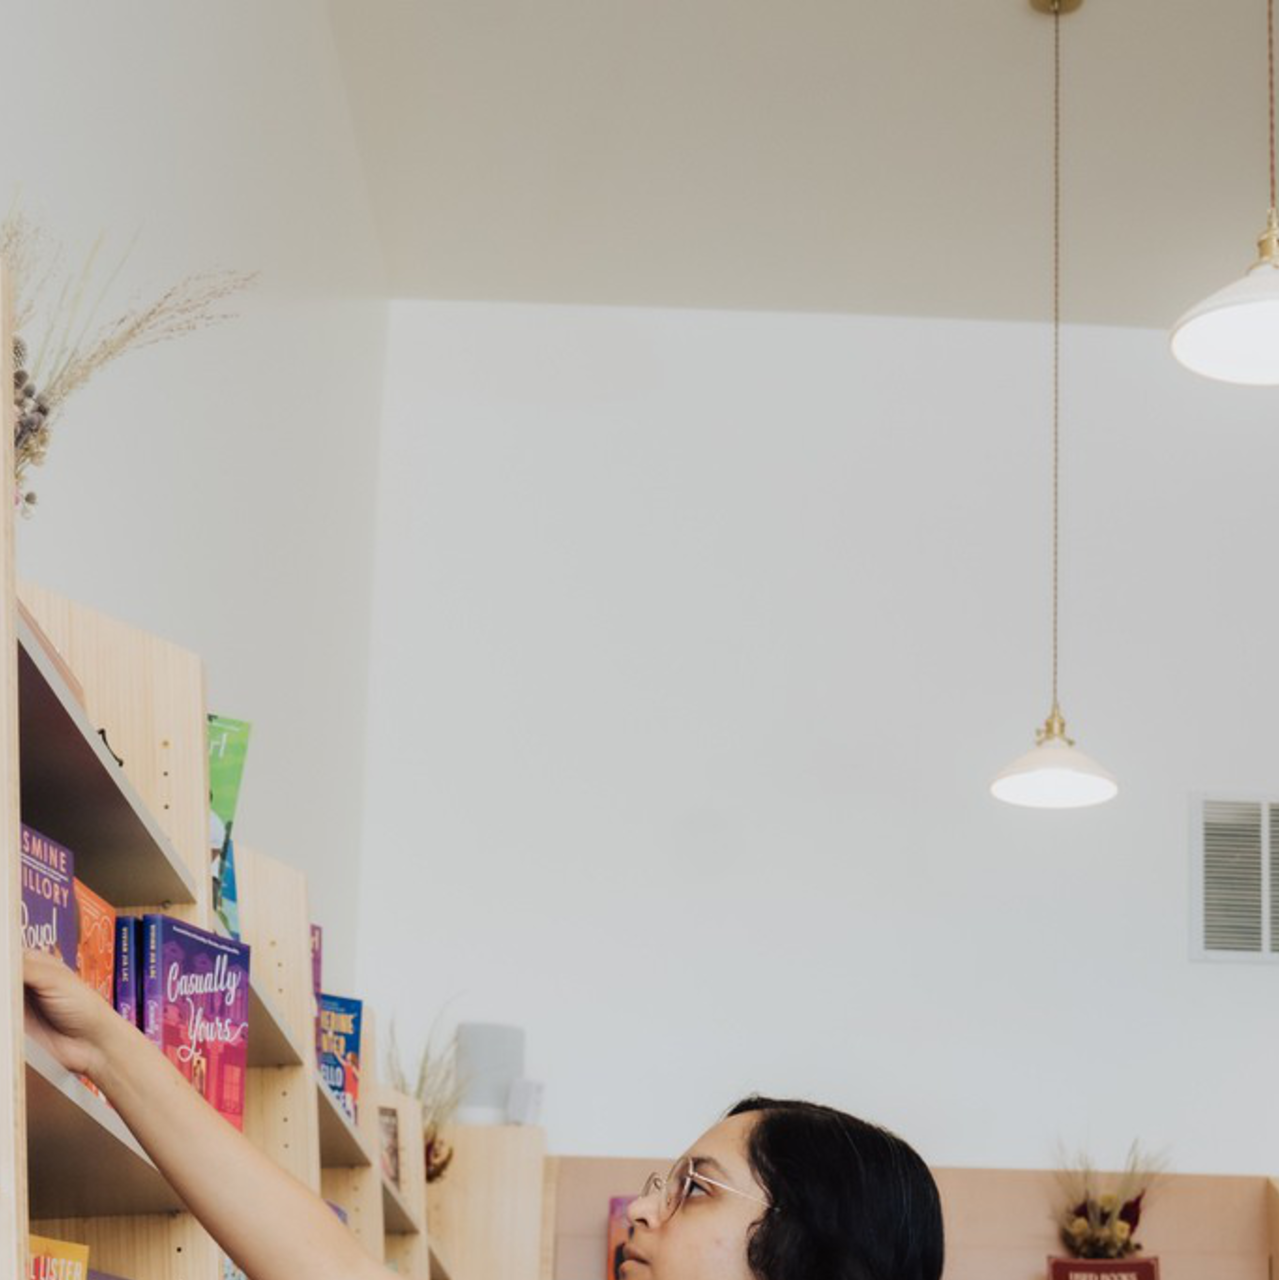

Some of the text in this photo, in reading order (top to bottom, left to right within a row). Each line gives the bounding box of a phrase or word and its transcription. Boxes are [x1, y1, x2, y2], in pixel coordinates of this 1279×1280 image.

[23, 830, 68, 874] SMINE
[23, 866, 69, 908] ILLORY
[20, 901, 58, 950] Royal
[167, 954, 241, 1006] Casually
[177, 996, 249, 1063] Yours
